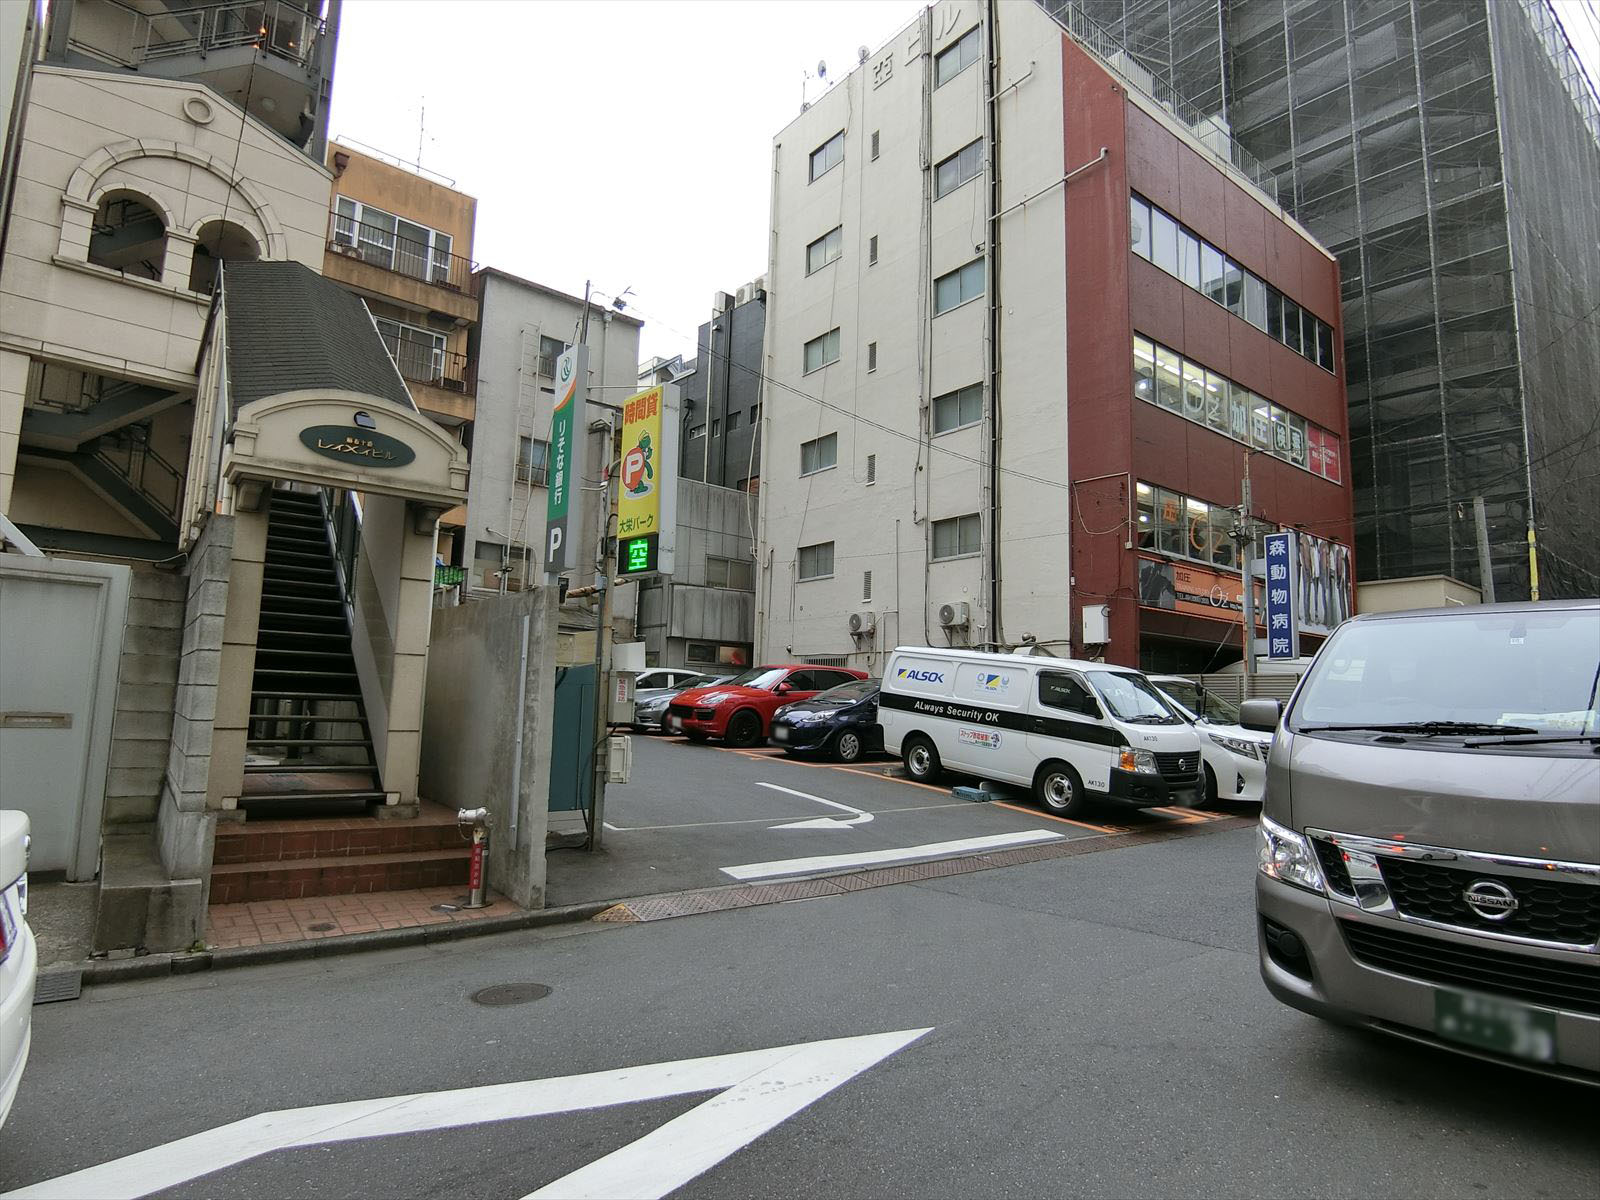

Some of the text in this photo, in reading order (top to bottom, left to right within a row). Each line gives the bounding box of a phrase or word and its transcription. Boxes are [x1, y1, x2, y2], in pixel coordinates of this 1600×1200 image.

[624, 392, 659, 424] 時間貸
[554, 420, 566, 505] りそな銀行
[625, 452, 643, 484] P
[619, 514, 654, 534] 大栄パーク
[549, 527, 562, 562] P
[629, 540, 648, 570] 空
[1175, 571, 1192, 583] 加圧
[1269, 540, 1289, 654] 森動物病院
[906, 669, 945, 684] ALSOK
[914, 700, 1000, 722] ALways Security OK
[1087, 780, 1105, 788] AK130
[1467, 895, 1516, 907] NISSAN
